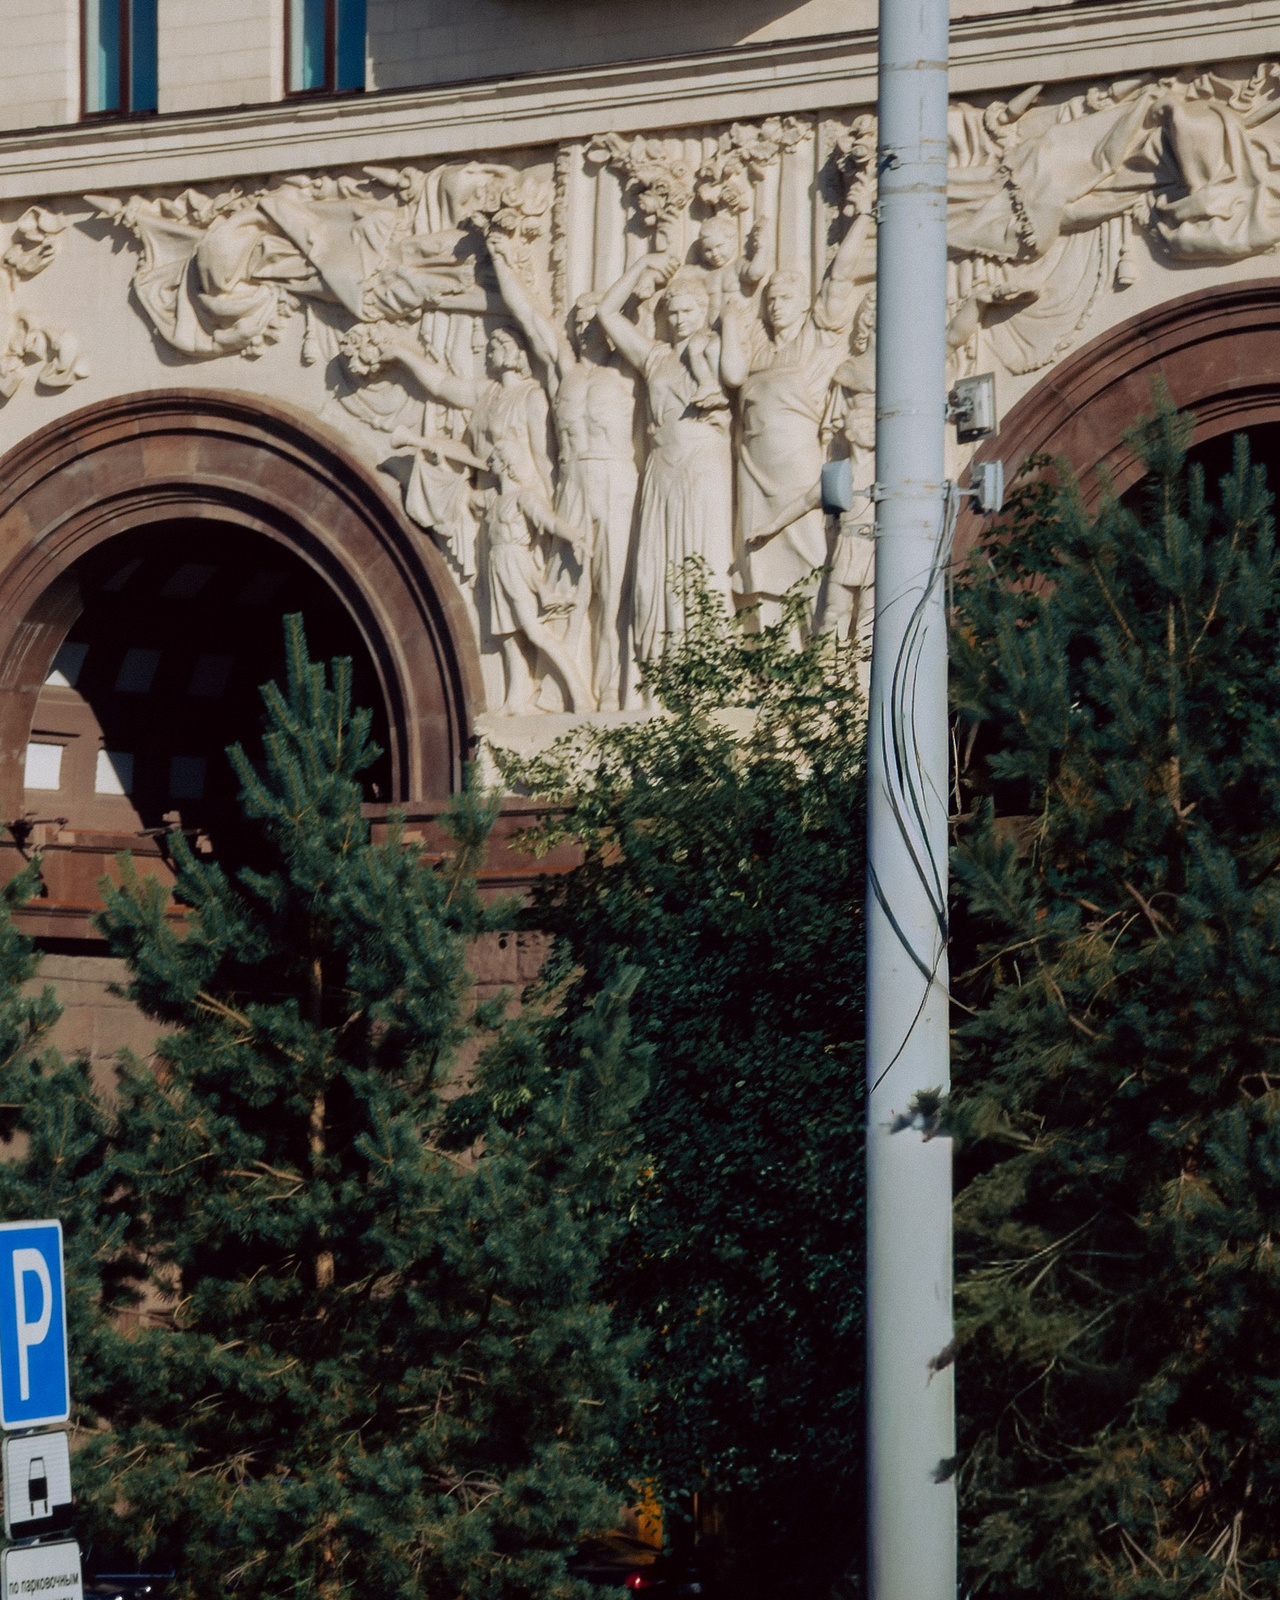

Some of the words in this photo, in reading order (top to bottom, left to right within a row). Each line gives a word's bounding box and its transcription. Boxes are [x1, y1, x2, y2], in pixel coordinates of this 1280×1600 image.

[12, 1248, 53, 1401] P
[9, 1581, 19, 1595] по
[21, 1572, 79, 1596] парковочным
